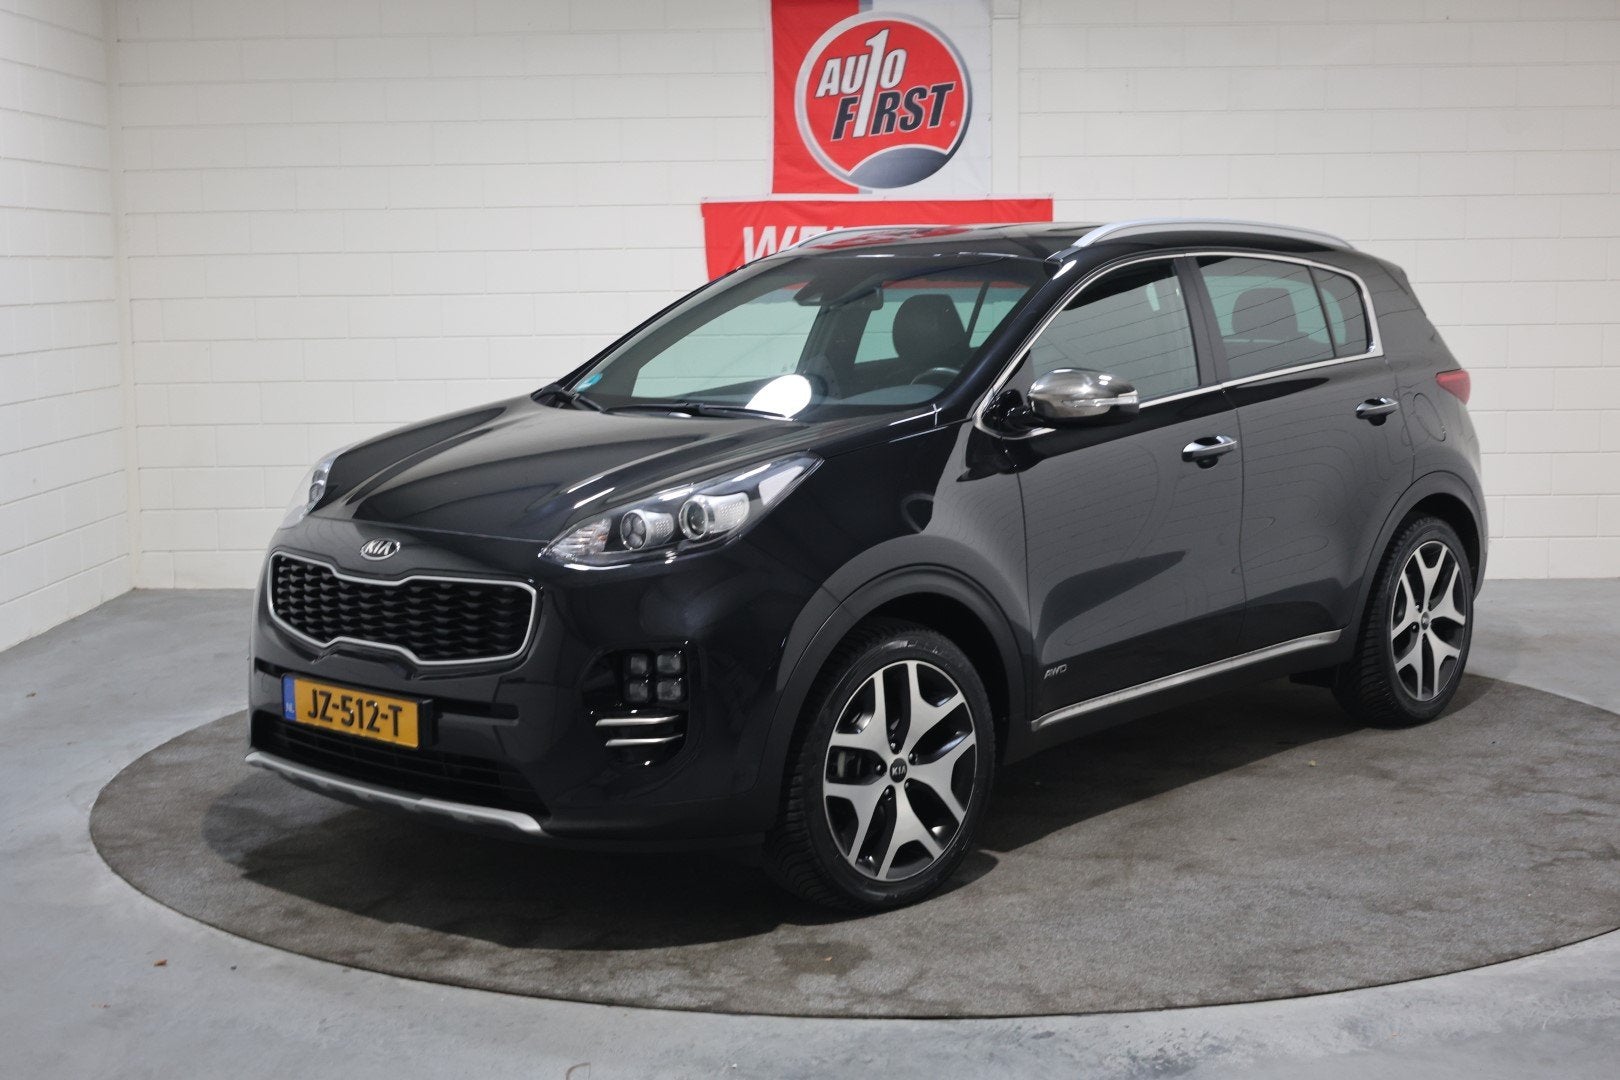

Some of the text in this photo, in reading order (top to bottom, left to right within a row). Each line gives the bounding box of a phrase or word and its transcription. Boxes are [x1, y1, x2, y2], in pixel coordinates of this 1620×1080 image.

[364, 539, 394, 556] KIA
[1043, 664, 1067, 680] AWD
[307, 688, 403, 737] JZ-512-T
[891, 765, 906, 776] KIA
